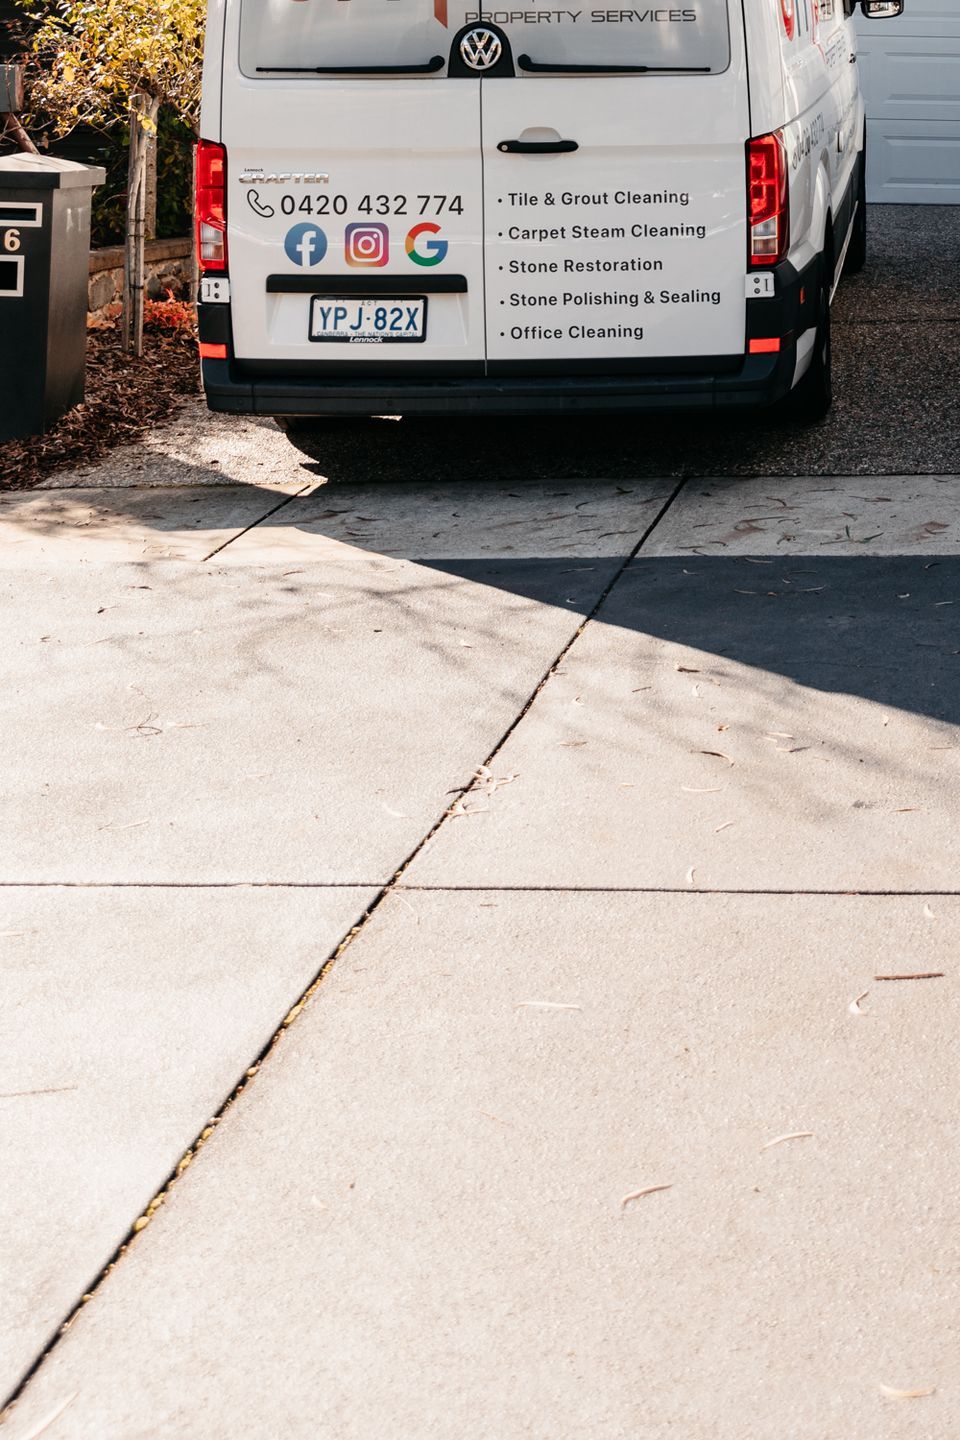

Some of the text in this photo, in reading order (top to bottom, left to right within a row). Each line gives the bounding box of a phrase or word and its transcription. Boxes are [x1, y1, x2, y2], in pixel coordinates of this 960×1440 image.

[465, 9, 697, 24] PROPERTY SERVICES
[239, 173, 329, 184] CRAFTER
[281, 195, 464, 215] 0420 432 774
[508, 190, 689, 206] Tile & Grout Cleaning
[4, 228, 21, 252] 6
[508, 223, 706, 241] Carpet Steam Cleaning
[509, 258, 663, 273] Stone Restoration
[510, 289, 721, 307] Stone Polishing & Sealing
[510, 325, 644, 340] Office Cleaning
